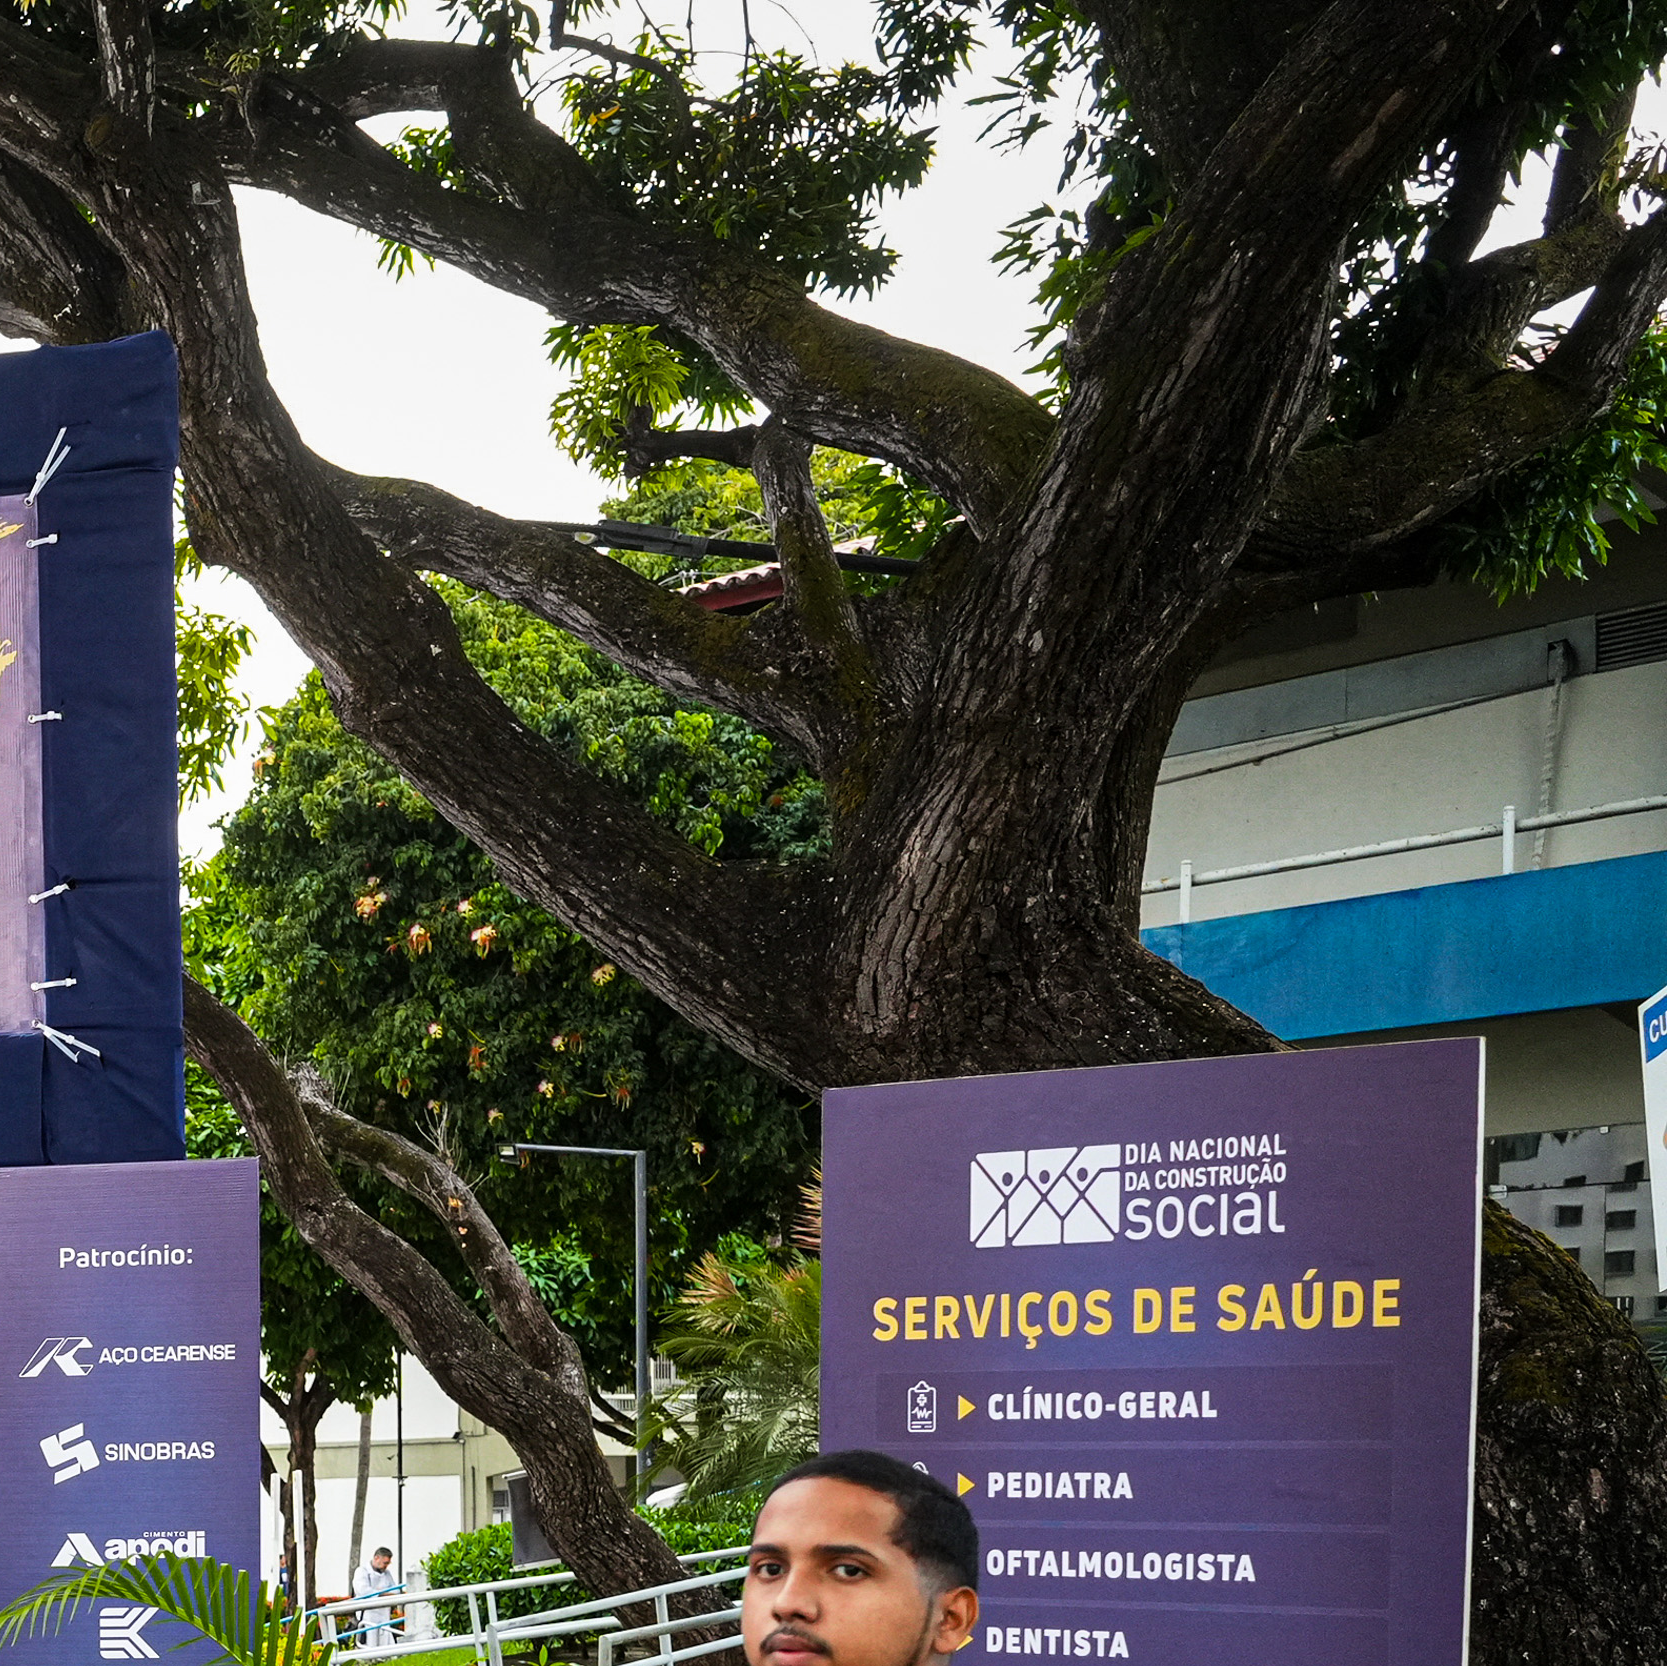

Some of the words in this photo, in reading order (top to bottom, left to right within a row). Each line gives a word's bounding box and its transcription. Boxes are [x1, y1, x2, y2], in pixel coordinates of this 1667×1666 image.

[1124, 1142, 1162, 1166] DIA
[1169, 1133, 1287, 1163] NACIONAL
[1124, 1170, 1151, 1192] DA
[1155, 1157, 1287, 1190] CONSTRUÇÃO
[59, 1243, 194, 1268] Patrocínio:
[872, 1290, 1113, 1350] SERVIÇOS
[1133, 1286, 1196, 1334] DE
[1216, 1268, 1402, 1332] SAÚDE
[98, 1347, 138, 1366] AÇO
[140, 1344, 236, 1363] CEARENSE
[987, 1386, 1218, 1421] CLÍNICO-GERAL
[105, 1441, 216, 1462] SINOBRAS
[987, 1471, 1134, 1500] PEDIATRA
[104, 1531, 206, 1566] apodi
[986, 1549, 1256, 1582] OFTALMOLOGISTA
[985, 1626, 1130, 1658] DENTISTA
